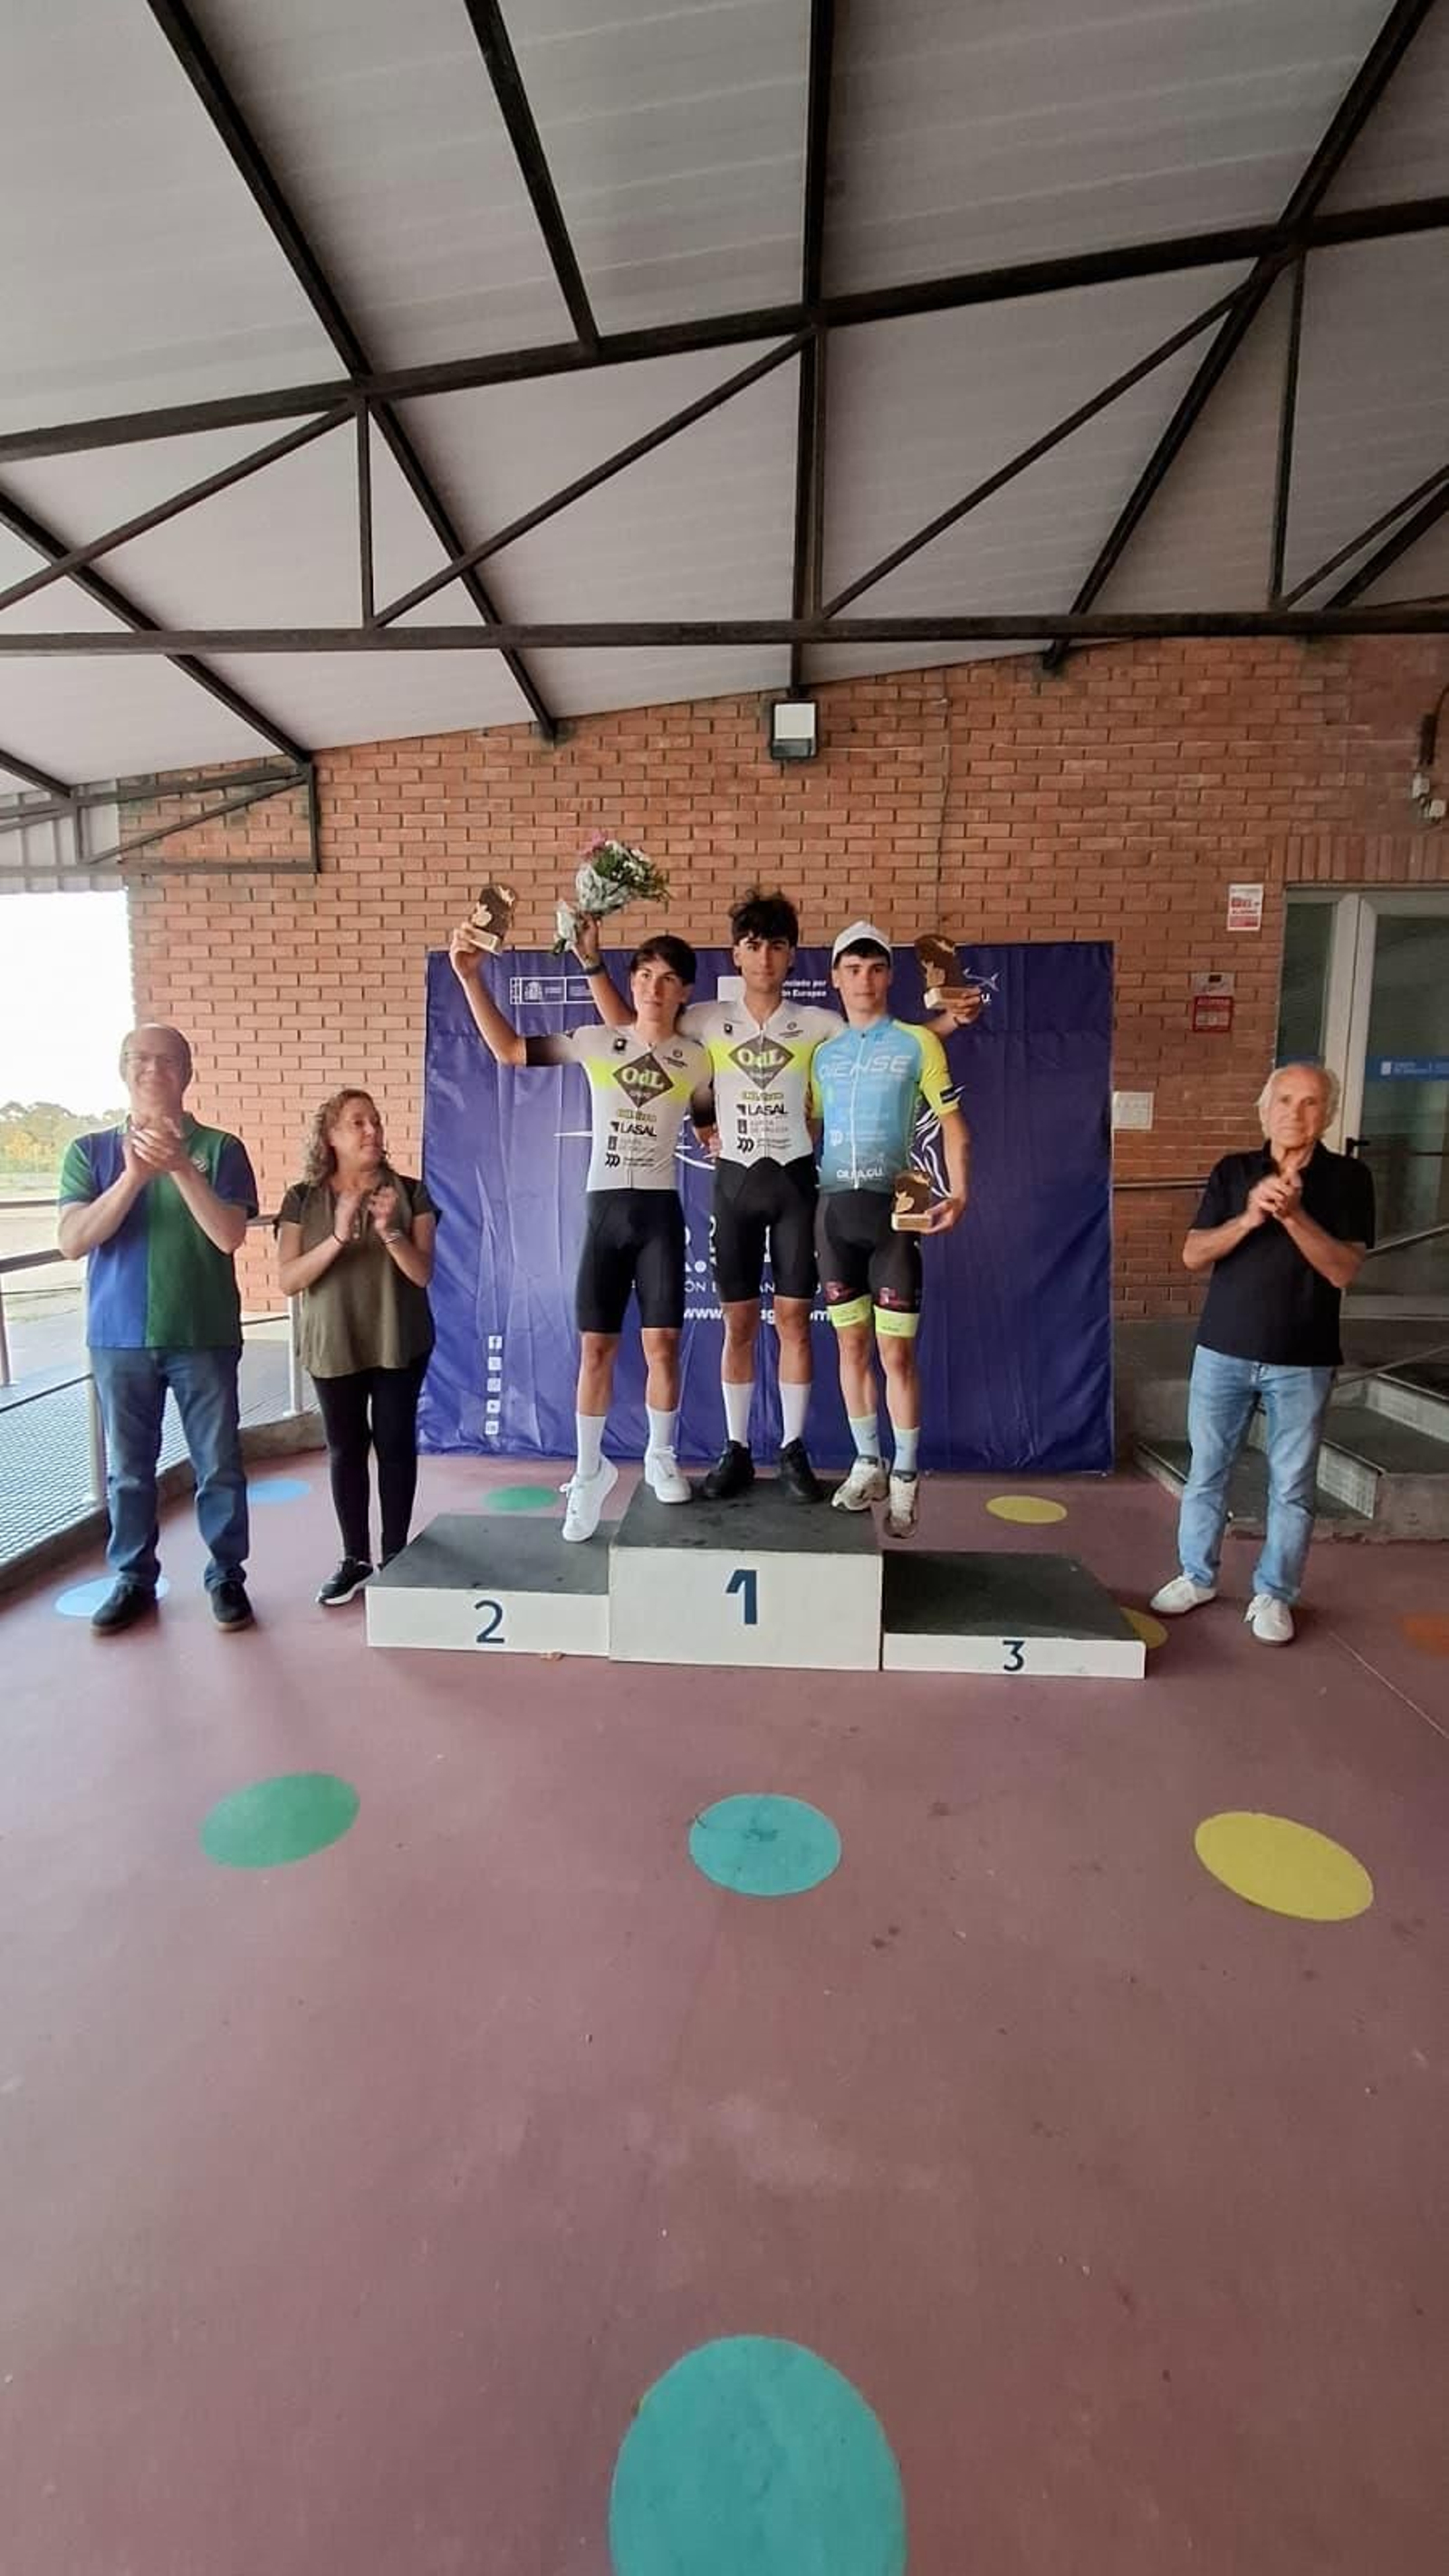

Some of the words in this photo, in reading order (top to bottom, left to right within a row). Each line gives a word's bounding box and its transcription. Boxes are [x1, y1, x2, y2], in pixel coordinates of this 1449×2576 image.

[620, 1066, 665, 1090] OdL
[747, 1103, 789, 1116] LASAL
[620, 1122, 657, 1137] LASAL
[725, 1569, 757, 1624] 1
[475, 1600, 504, 1644] 2
[1003, 1639, 1025, 1671] 3
